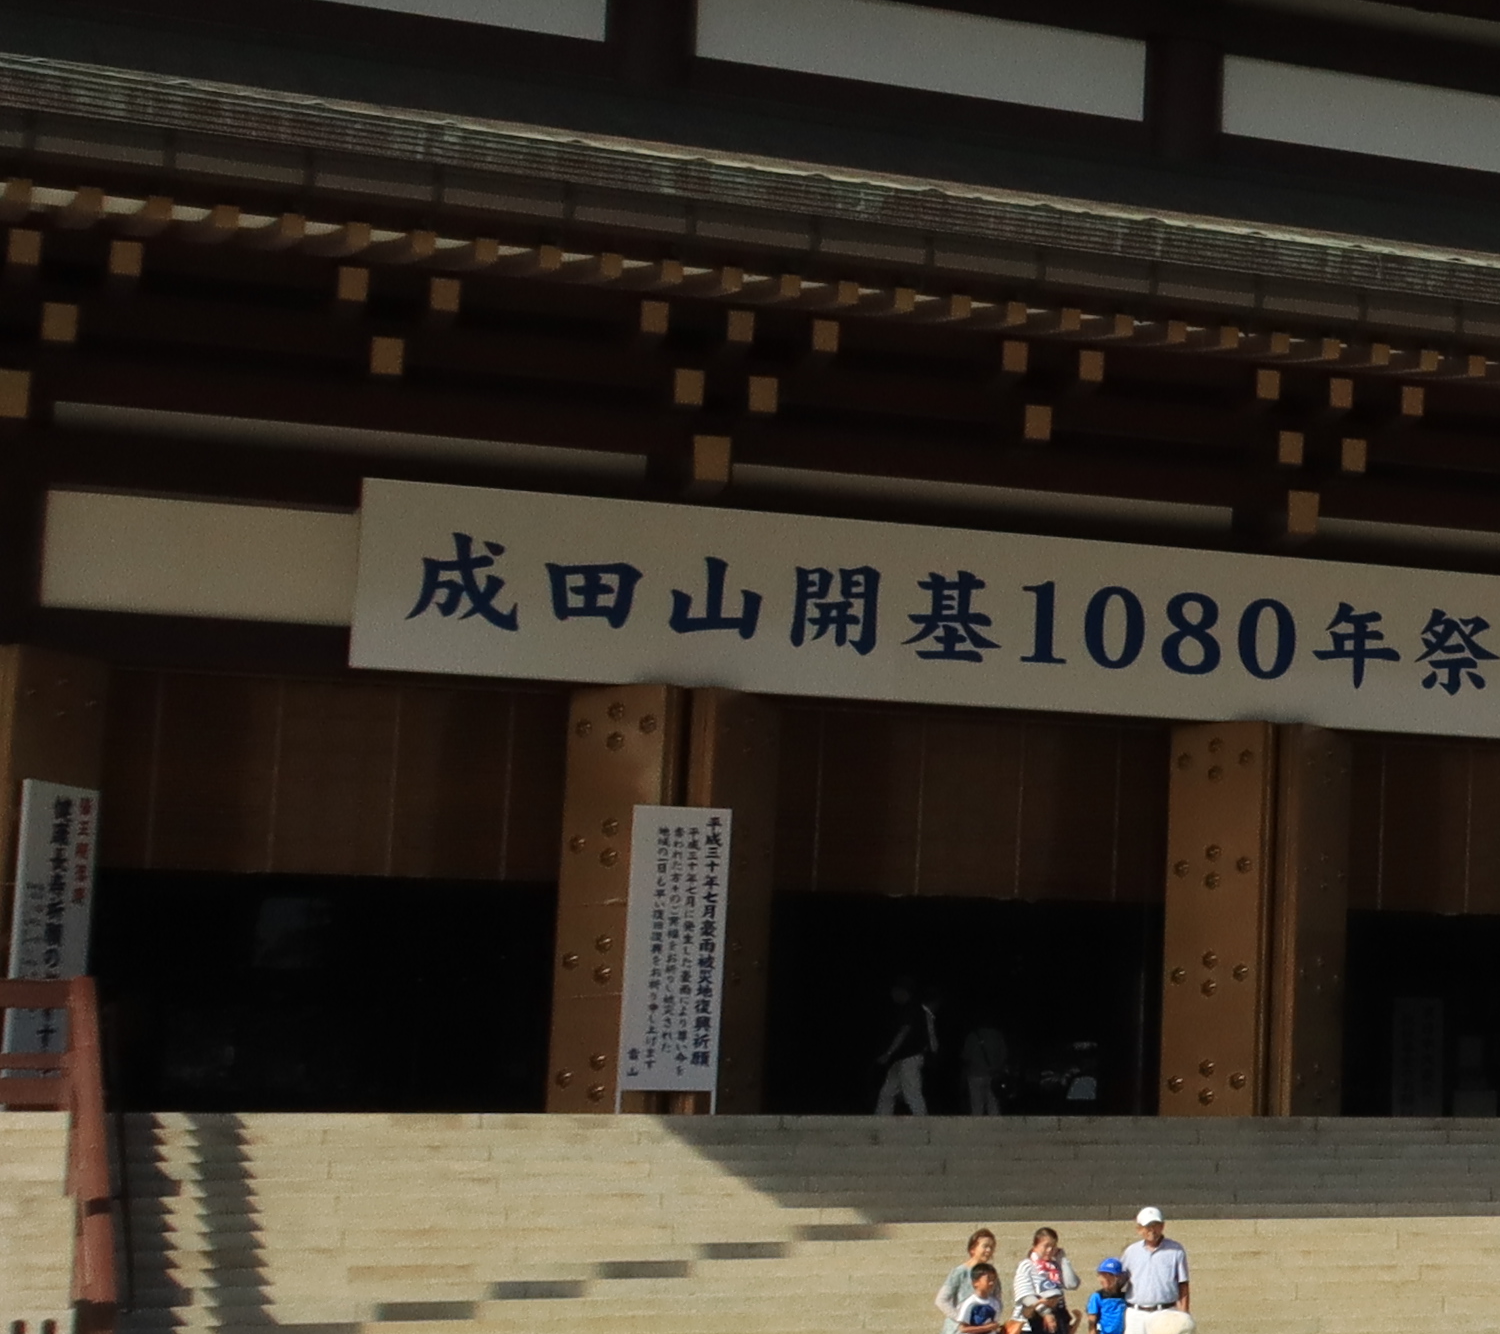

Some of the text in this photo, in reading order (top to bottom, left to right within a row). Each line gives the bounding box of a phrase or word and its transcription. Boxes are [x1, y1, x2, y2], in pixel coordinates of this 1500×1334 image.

[690, 817, 722, 1067] 平成三十年七月豪雨被災地復興祈願
